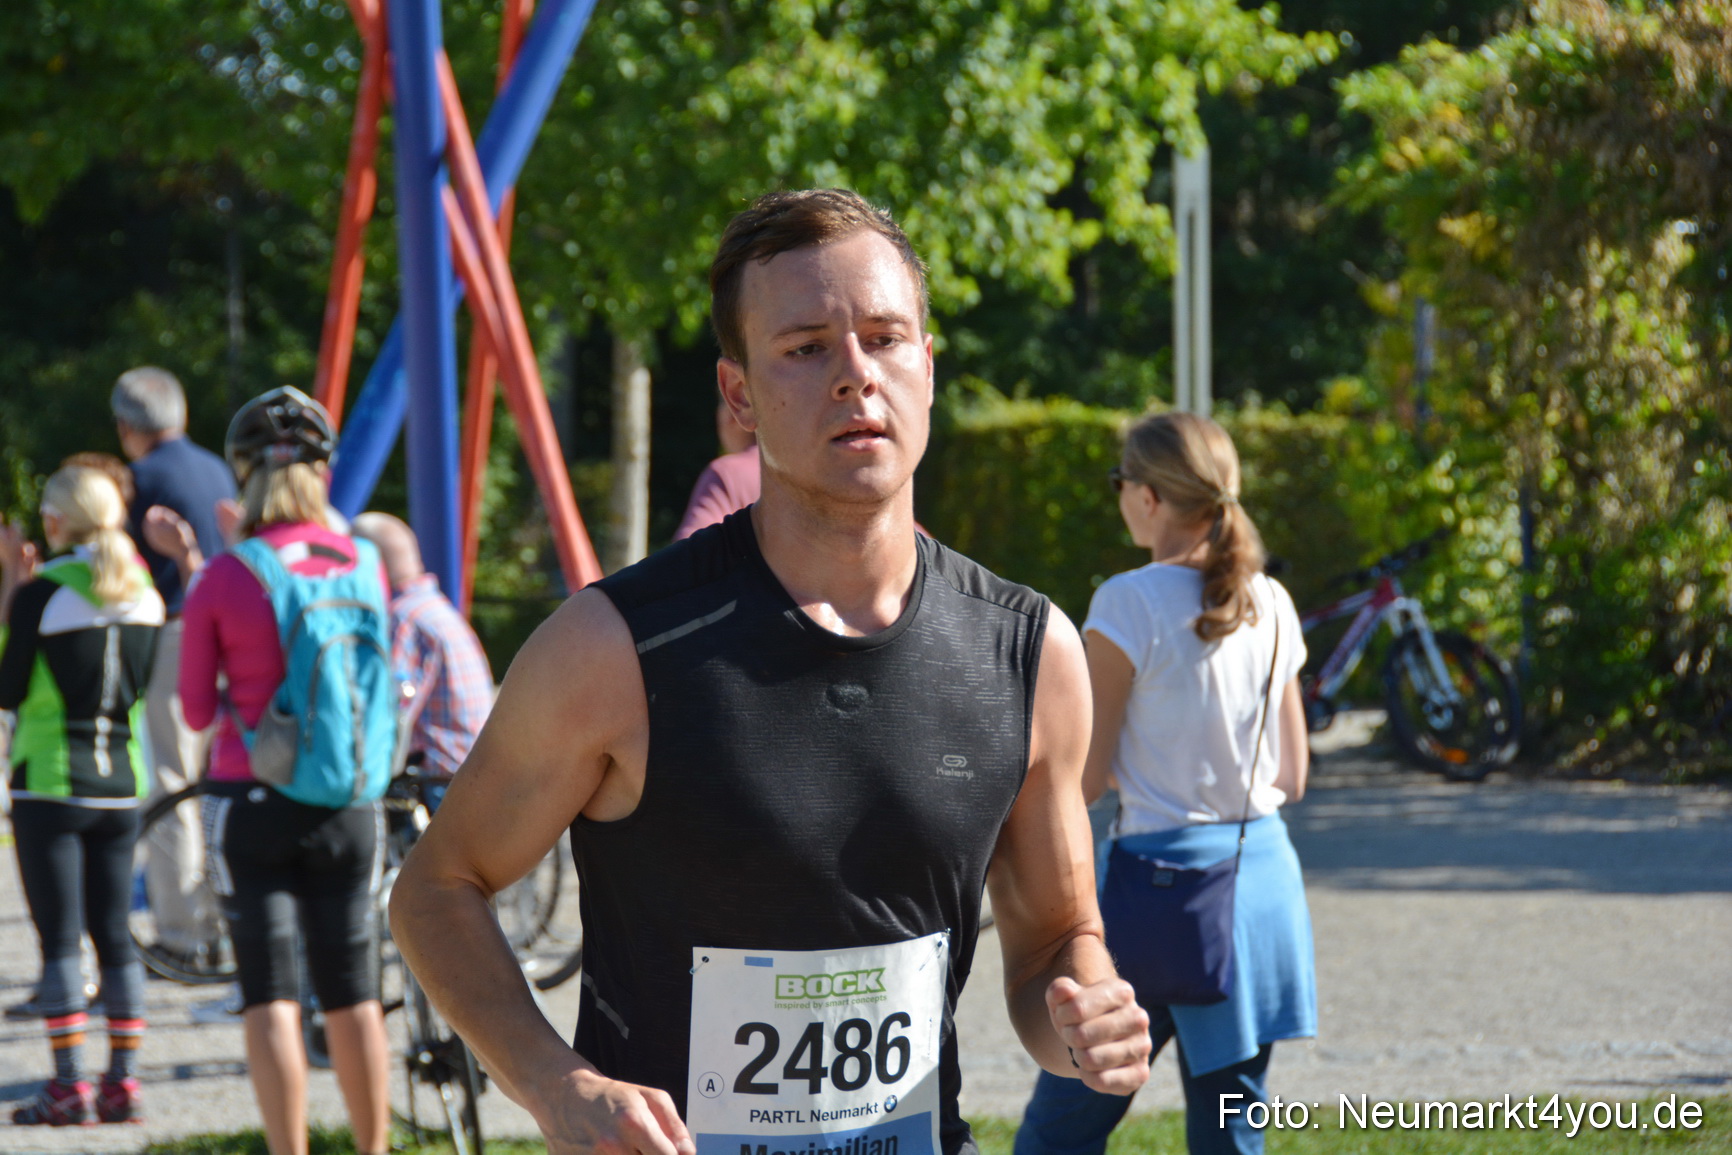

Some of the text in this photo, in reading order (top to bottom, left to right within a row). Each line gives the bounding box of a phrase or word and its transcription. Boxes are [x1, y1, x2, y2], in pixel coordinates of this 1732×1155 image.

[774, 967, 887, 1000] BOCK
[774, 995, 887, 1010] inspired by smart concepts
[733, 1011, 912, 1096] 2486
[705, 1079, 716, 1093] A
[750, 1101, 879, 1124] PARTL Neumarkt
[740, 1135, 898, 1155] ilian
